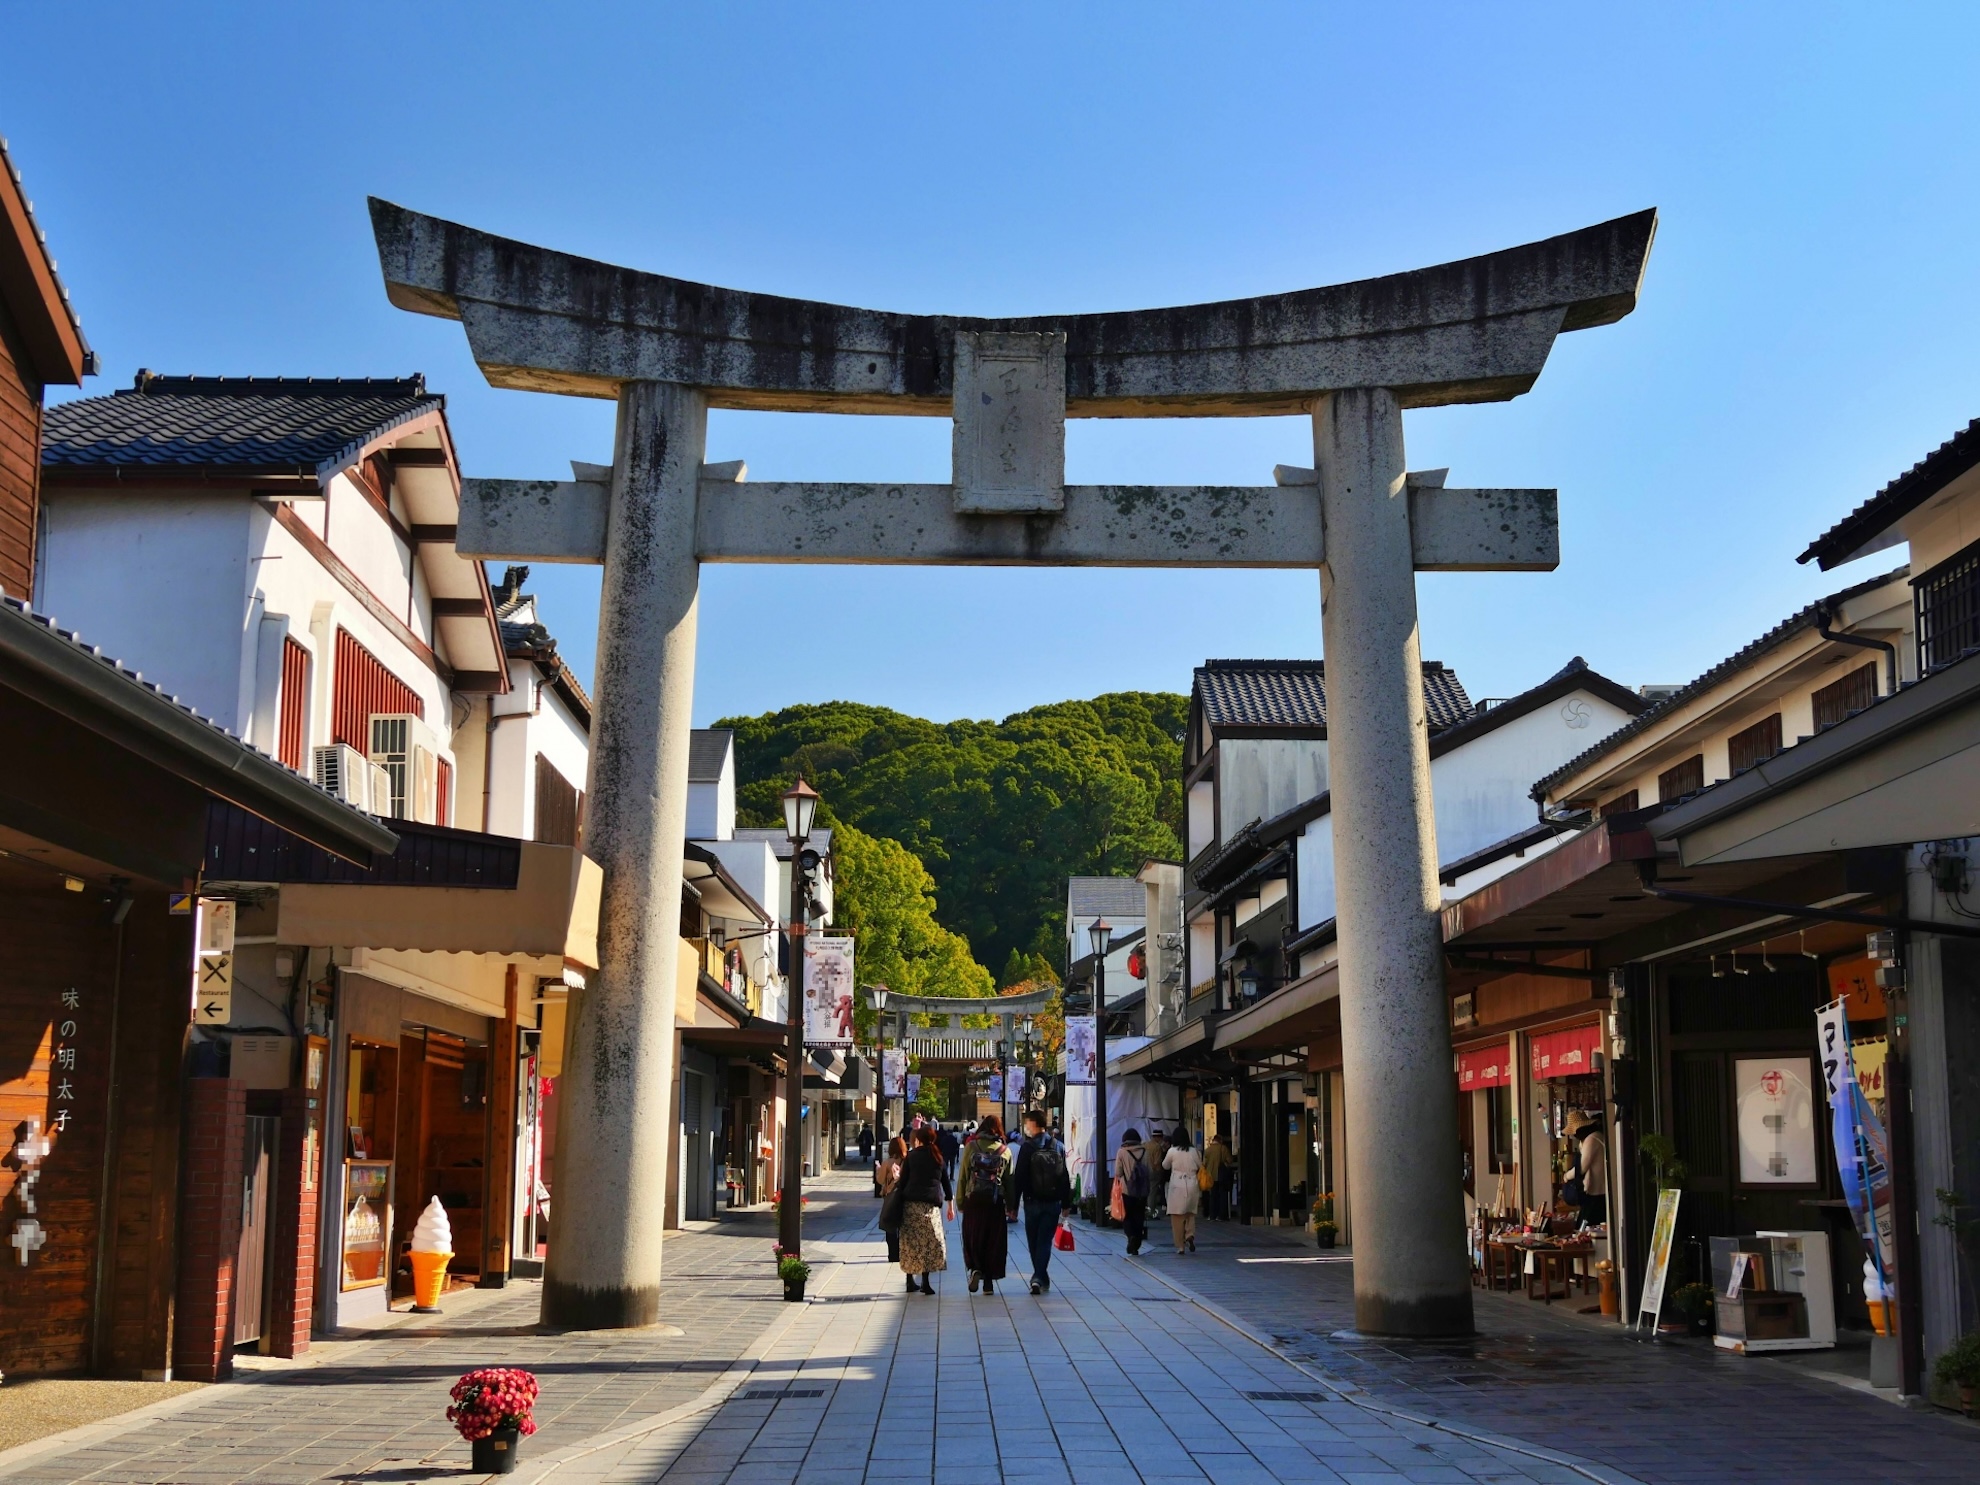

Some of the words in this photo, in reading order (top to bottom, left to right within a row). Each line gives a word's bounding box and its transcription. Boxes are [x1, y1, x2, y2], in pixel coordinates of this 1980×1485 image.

[53, 987, 80, 1132] 味の明太子
